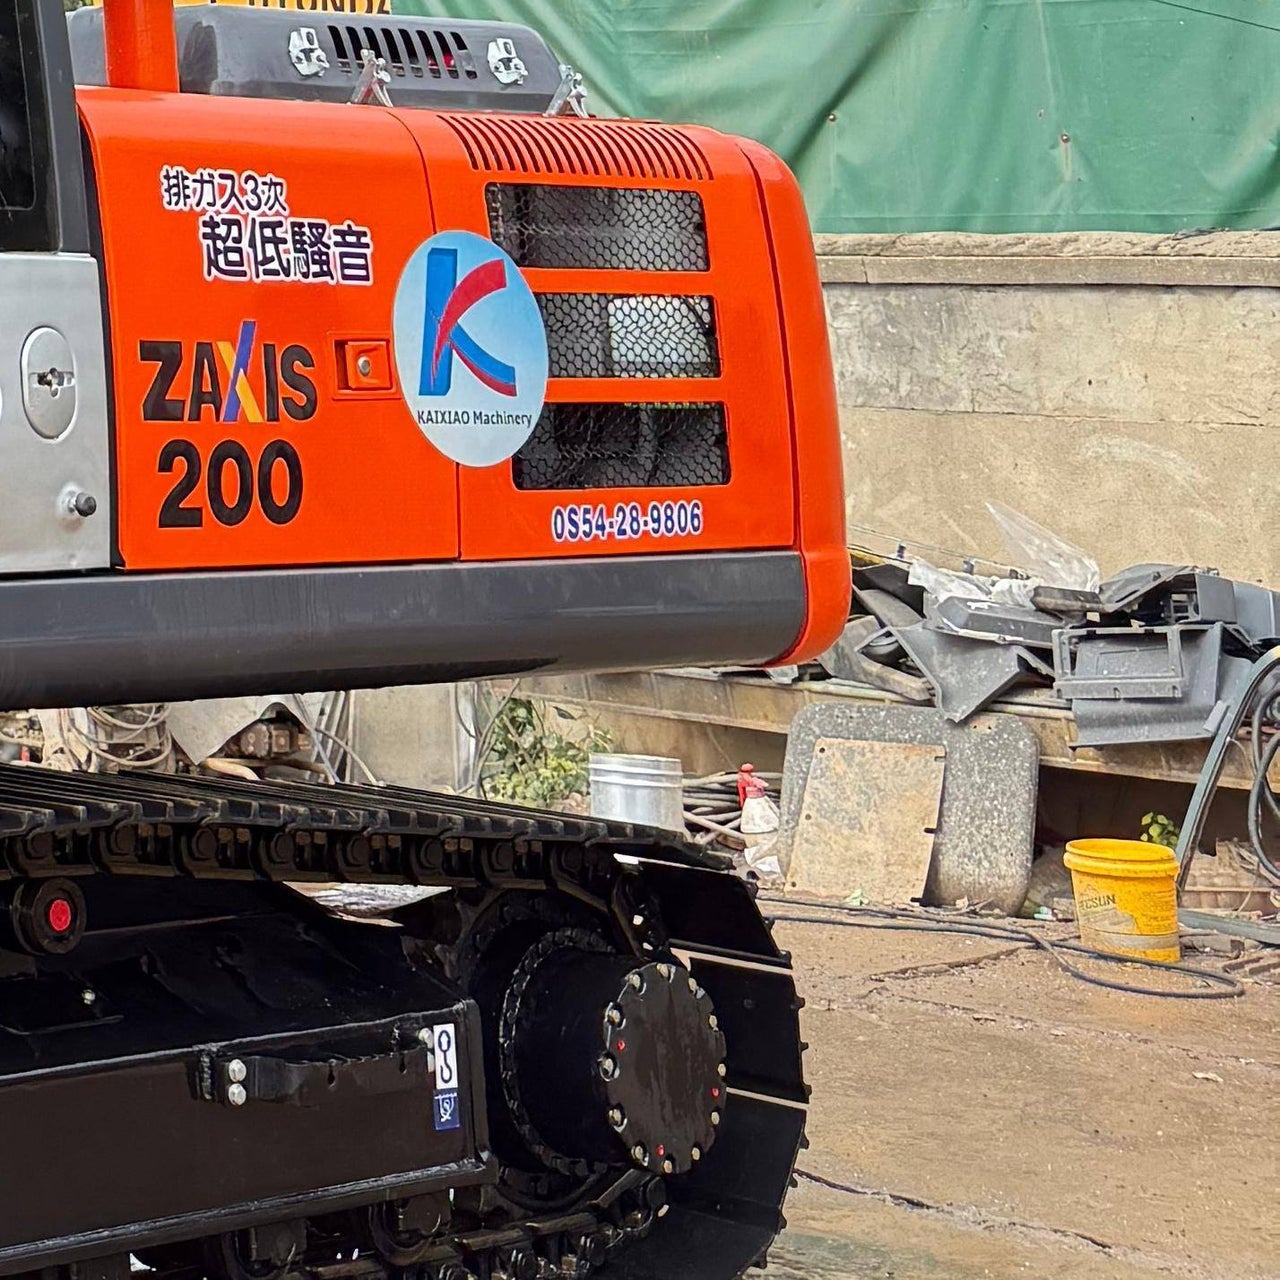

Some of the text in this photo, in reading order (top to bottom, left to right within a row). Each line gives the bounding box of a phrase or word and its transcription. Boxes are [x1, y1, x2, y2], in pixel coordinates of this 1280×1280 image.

[161, 166, 288, 213] 排ガス3次
[200, 213, 372, 282] 超低騒音
[139, 320, 319, 423] ZAXIS
[417, 409, 533, 428] KAIXIAO Machinery
[157, 439, 303, 528] 200
